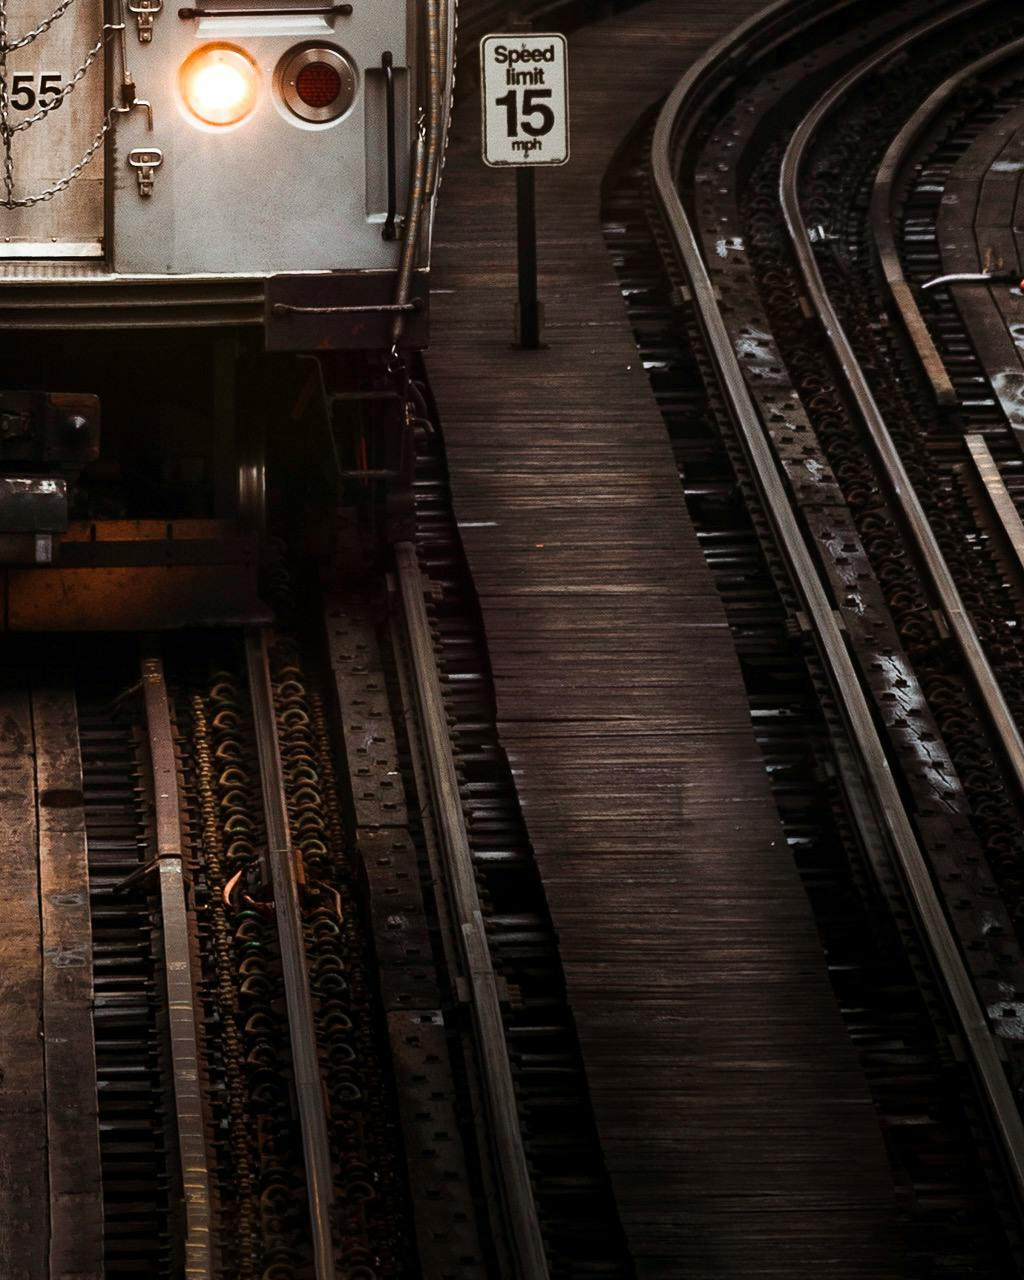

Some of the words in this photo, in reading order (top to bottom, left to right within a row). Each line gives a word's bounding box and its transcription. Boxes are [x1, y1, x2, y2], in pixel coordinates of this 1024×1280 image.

[494, 45, 555, 67] Speed
[506, 67, 545, 86] limit
[495, 89, 555, 137] 15
[511, 137, 543, 154] mph
